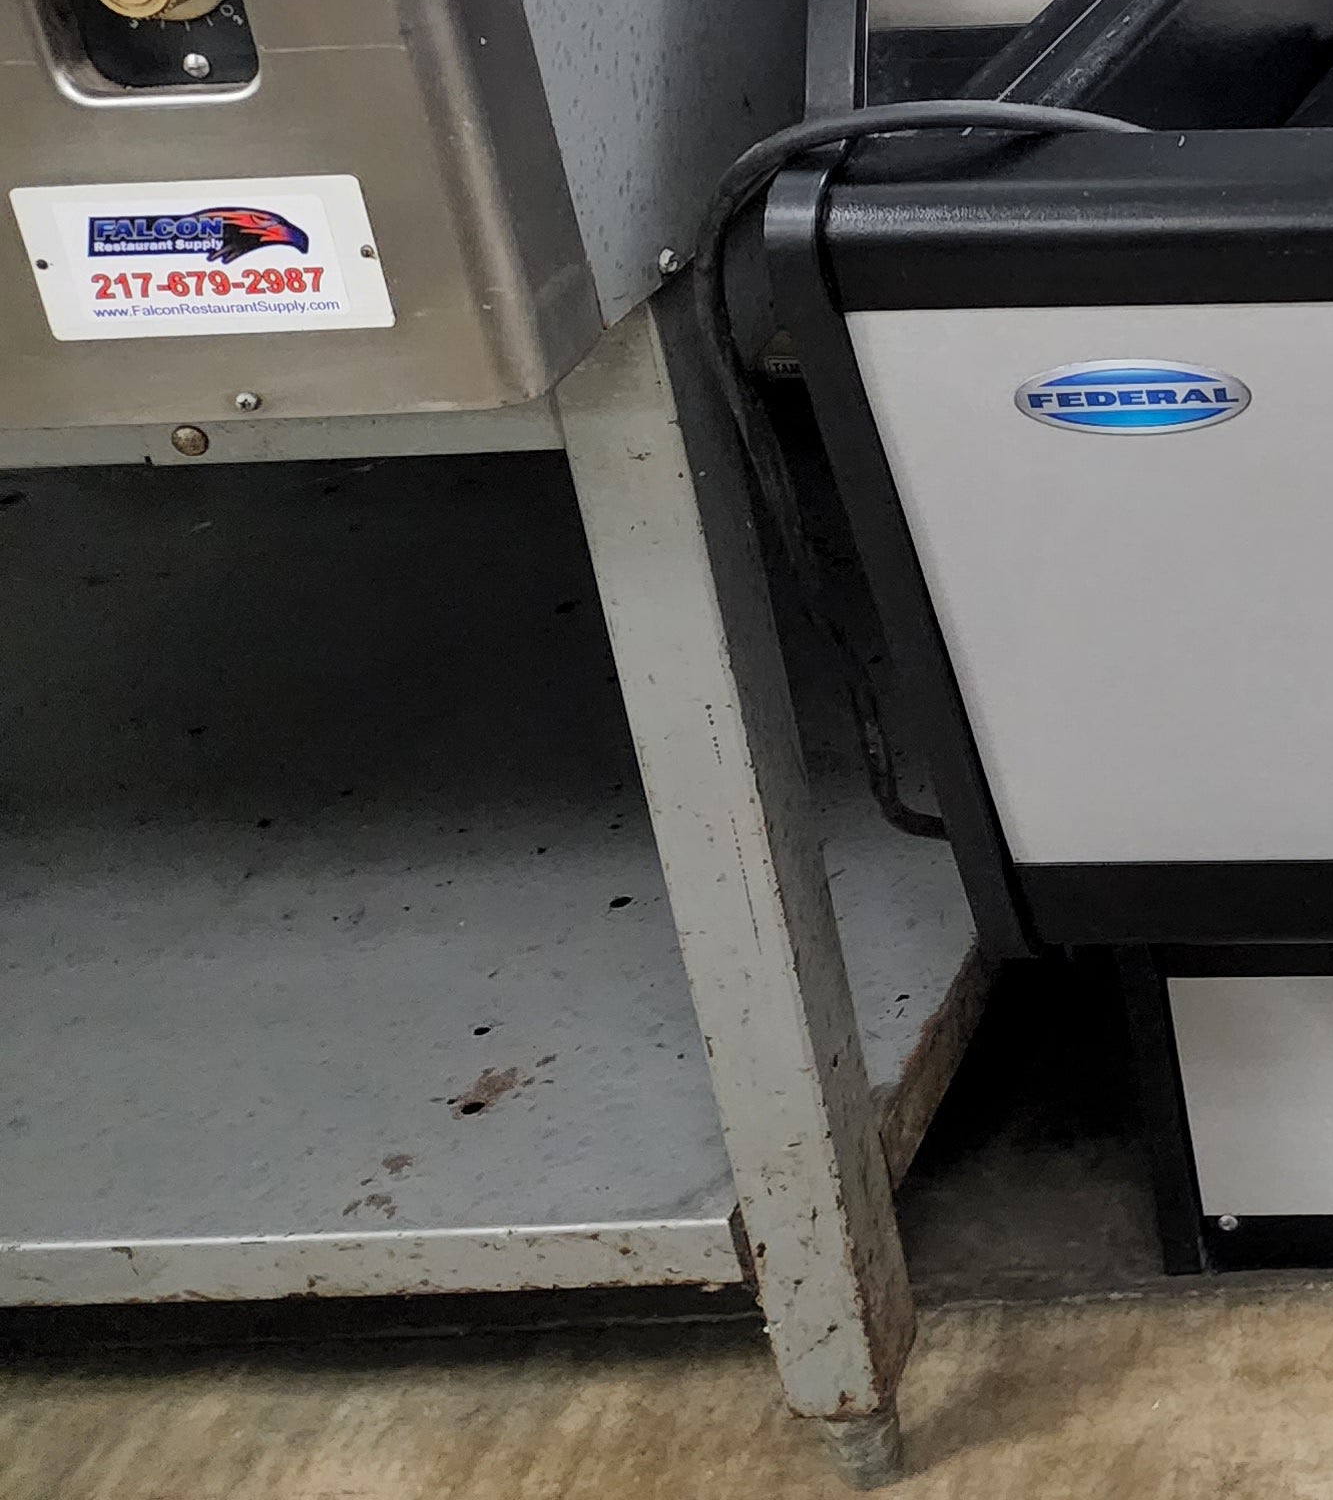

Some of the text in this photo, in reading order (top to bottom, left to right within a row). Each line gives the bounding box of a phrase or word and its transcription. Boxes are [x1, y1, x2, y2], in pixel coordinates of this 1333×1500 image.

[94, 217, 224, 240] FALCON
[94, 238, 224, 252] Restaurant Supply
[91, 267, 324, 300] 217-679-2987
[93, 299, 340, 318] www.FalconRestaurantSupply.com
[1027, 387, 1239, 409] FEDERAL
